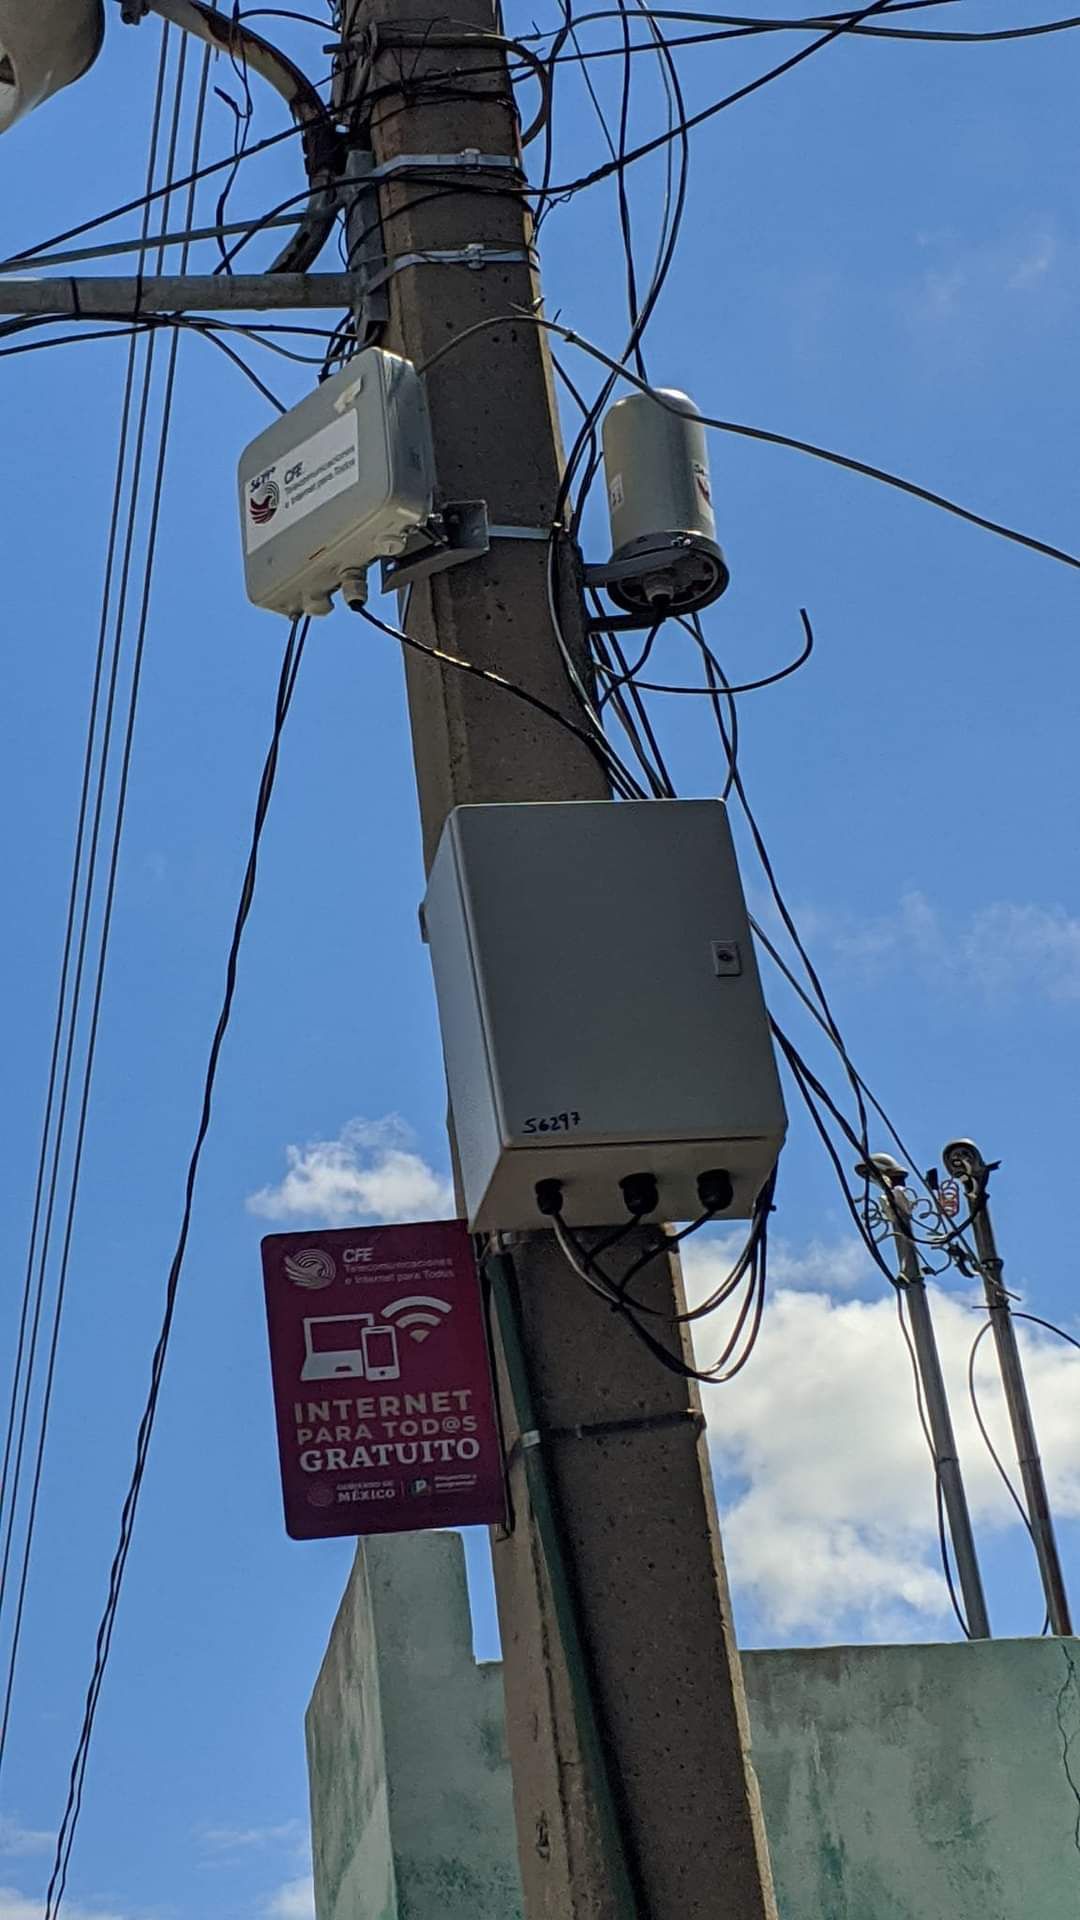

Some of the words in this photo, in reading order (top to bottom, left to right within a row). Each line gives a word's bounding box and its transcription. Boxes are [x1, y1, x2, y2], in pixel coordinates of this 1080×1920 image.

[284, 461, 303, 485] CFE
[522, 1111, 581, 1133] S6297
[343, 1247, 374, 1263] CFE
[294, 1389, 472, 1424] INTERNET
[297, 1423, 373, 1446] PARA
[382, 1415, 478, 1439] TOD@S
[300, 1437, 480, 1472] GRATUITO
[337, 1488, 396, 1502] MÉXICO
